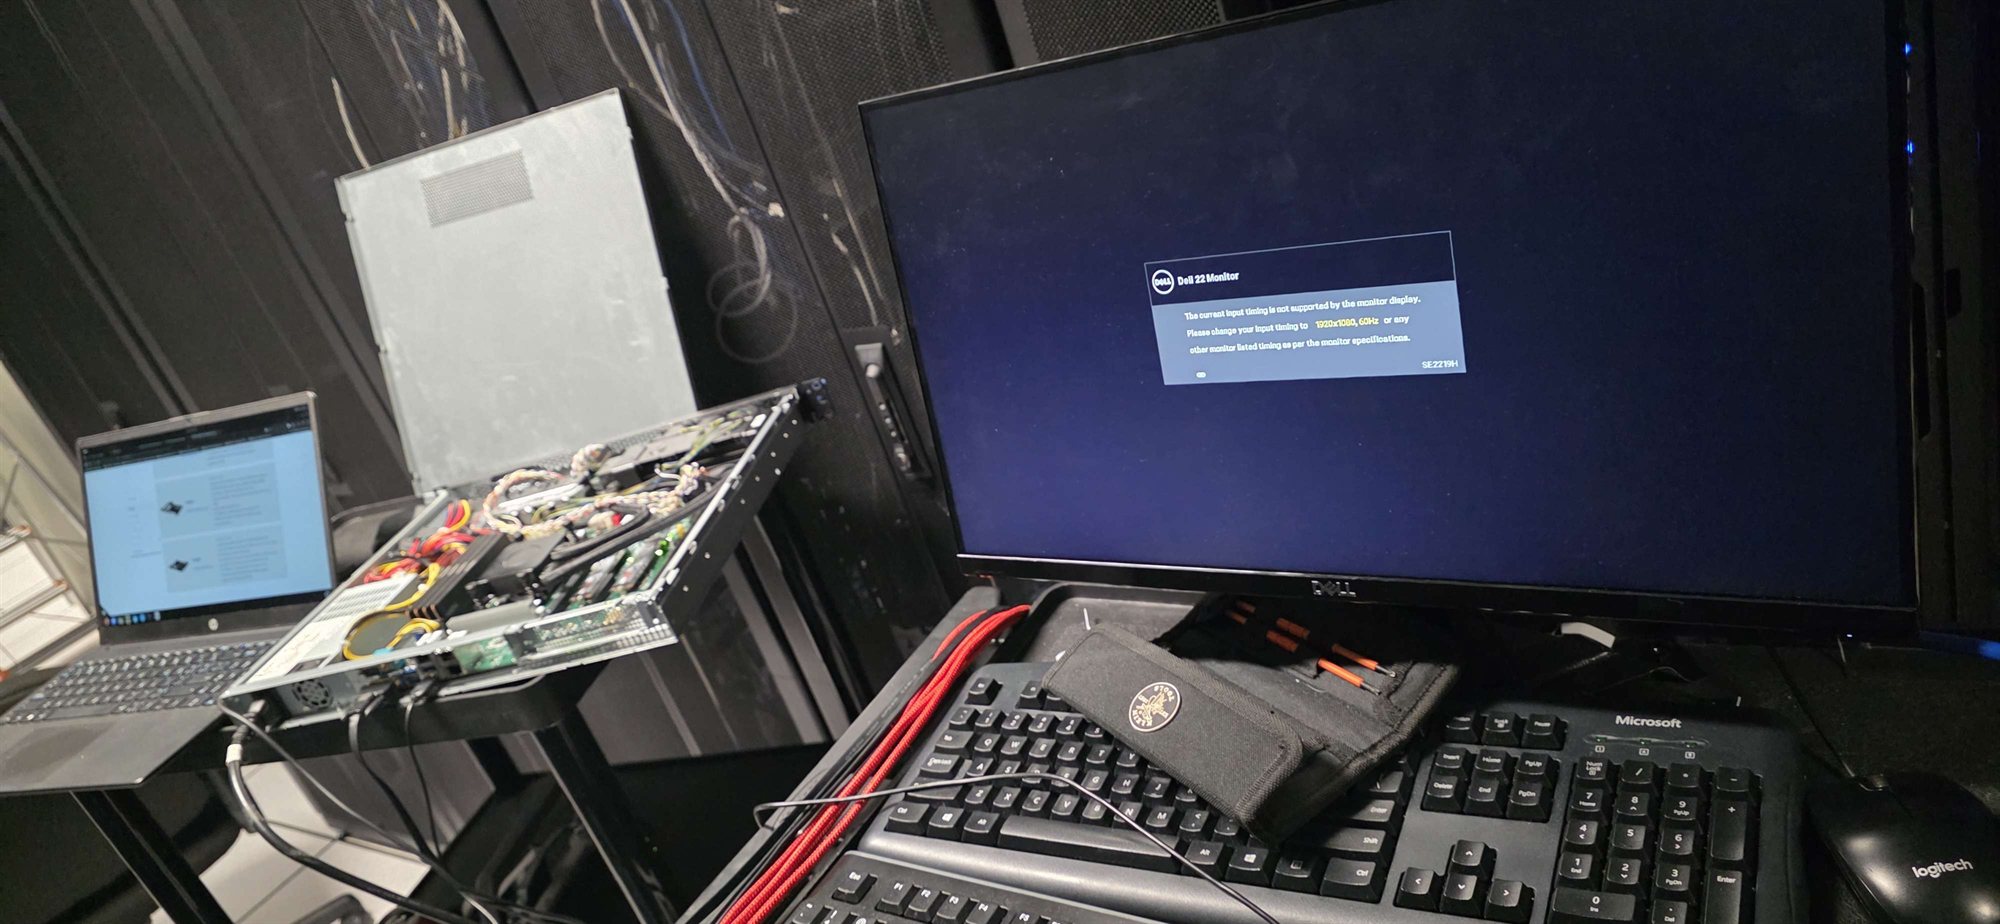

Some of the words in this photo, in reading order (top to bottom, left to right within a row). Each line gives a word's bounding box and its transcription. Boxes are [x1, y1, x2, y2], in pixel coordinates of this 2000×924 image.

[1177, 276, 1194, 286] Dell
[1194, 274, 1206, 284] 22
[1206, 271, 1240, 283] Monitor
[1184, 312, 1198, 320] The
[1199, 308, 1226, 320] current
[1226, 308, 1244, 318] input
[1245, 306, 1268, 316] timing
[1268, 306, 1276, 314] is
[1276, 304, 1290, 313] not
[1290, 300, 1329, 313] supported
[1330, 300, 1340, 310] by
[1342, 299, 1356, 308] the
[1357, 296, 1388, 307] monitor
[1389, 294, 1422, 306] display.
[1186, 328, 1210, 338] Please
[1211, 325, 1237, 336] change
[1238, 326, 1254, 336] your
[1255, 324, 1274, 335] input
[1274, 322, 1299, 334] timing
[1300, 322, 1308, 330] to
[1315, 318, 1358, 329] 1920x1080,
[1358, 316, 1380, 326] 60Hz
[1384, 316, 1394, 324] or
[1394, 314, 1410, 325] any
[1190, 344, 1208, 354] other
[1209, 343, 1236, 353] monitor
[1236, 342, 1258, 352] listed
[1258, 340, 1282, 350] timing
[1292, 340, 1306, 350] per
[1306, 338, 1320, 347] the
[1321, 336, 1350, 347] monitor
[1352, 334, 1411, 346] specifications.
[1422, 360, 1459, 370] SE2219H
[1311, 580, 1356, 598] DELL
[1153, 685, 1176, 702] TOOLS
[1132, 708, 1152, 727] KLEIN
[1615, 714, 1682, 729] Microsoft
[984, 738, 992, 747] Q
[1010, 740, 1020, 748] W
[1068, 746, 1076, 755] R
[1128, 752, 1136, 760] Y
[976, 762, 984, 770] A
[1586, 760, 1603, 768] Num
[1004, 766, 1012, 774] S
[1092, 776, 1100, 784] G
[1122, 778, 1132, 787] H
[976, 790, 984, 798] Z
[1004, 793, 1012, 801] X
[1586, 792, 1594, 800] 7
[1033, 797, 1041, 805] C
[1632, 796, 1639, 804] 8
[1678, 800, 1687, 808] 9
[1064, 801, 1071, 809] V
[1125, 808, 1134, 816] N
[1156, 812, 1166, 820] M
[1579, 824, 1587, 832] 4
[1626, 828, 1634, 837] 5
[1363, 836, 1378, 845] Shift
[1674, 834, 1682, 842] 6
[1575, 858, 1581, 866] 1
[1622, 863, 1630, 872] 2
[1912, 858, 1974, 878] logitech
[1356, 870, 1369, 878] Ctrl
[1671, 868, 1679, 878] 3
[1716, 875, 1737, 884] Enter
[894, 882, 904, 891] F1
[921, 889, 931, 898] F2
[1592, 896, 1600, 904] 0
[978, 903, 988, 912] F4
